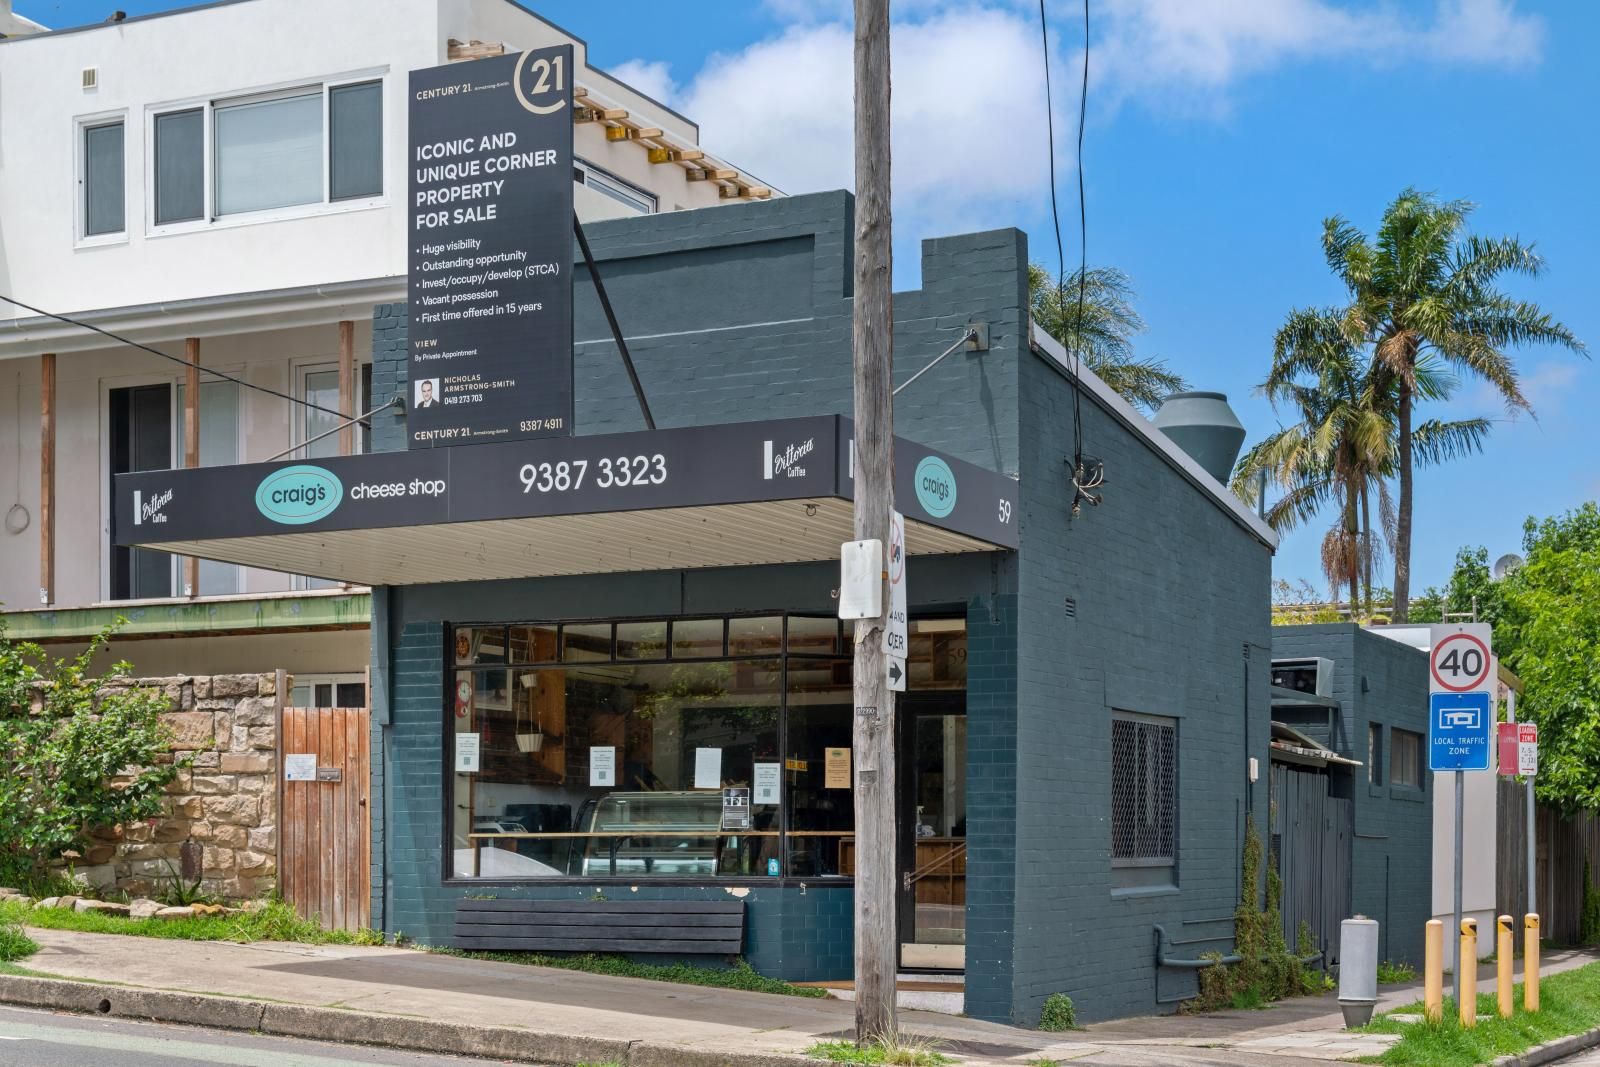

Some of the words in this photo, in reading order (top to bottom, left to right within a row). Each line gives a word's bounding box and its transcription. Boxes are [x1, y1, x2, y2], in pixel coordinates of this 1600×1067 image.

[416, 84, 461, 101] CENTURY
[416, 138, 474, 161] ICONIC
[479, 132, 517, 152] AND
[416, 160, 480, 184] UNIQUE
[484, 149, 557, 174] CORNER
[416, 180, 504, 207] PROPERTY
[416, 211, 449, 230] FOR
[453, 204, 497, 224] SALE
[422, 244, 445, 256] Huge
[446, 238, 481, 250] visibility
[422, 257, 474, 271] Outstanding
[475, 250, 527, 265] opportunity
[422, 268, 522, 289] Invest/occupy/develop
[524, 262, 560, 279] (STCA)
[422, 294, 450, 306] Vacant
[451, 289, 498, 304] possession
[421, 312, 441, 323] First
[442, 310, 461, 321] time
[462, 305, 494, 318] offered
[495, 305, 504, 314] in
[505, 303, 516, 313] 15
[517, 302, 542, 315] years
[415, 339, 438, 348] VIEW
[414, 354, 422, 362] By
[422, 352, 441, 361] Private
[441, 349, 478, 359] Appointment
[444, 374, 481, 384] NICHOLAS
[444, 380, 515, 393] ARMSTRONG-SMITH
[458, 395, 470, 404] 273
[471, 394, 483, 403] 703
[520, 419, 542, 432] 9387
[544, 418, 563, 429] 4911
[414, 428, 459, 441] CENTURY
[774, 437, 814, 475] Vittoria
[519, 460, 588, 494] 9387
[596, 454, 667, 488] 3323
[787, 465, 806, 478] Coffee
[271, 483, 326, 506] craig's
[350, 480, 406, 500] cheese
[408, 478, 446, 497] shop
[922, 475, 949, 501] craig's
[152, 513, 168, 523] Coffee
[998, 497, 1011, 524] 59
[1438, 648, 1483, 677] 40
[1434, 737, 1455, 745] LOCAL
[1521, 733, 1534, 742] ZONE
[1448, 747, 1471, 755] ZONE
